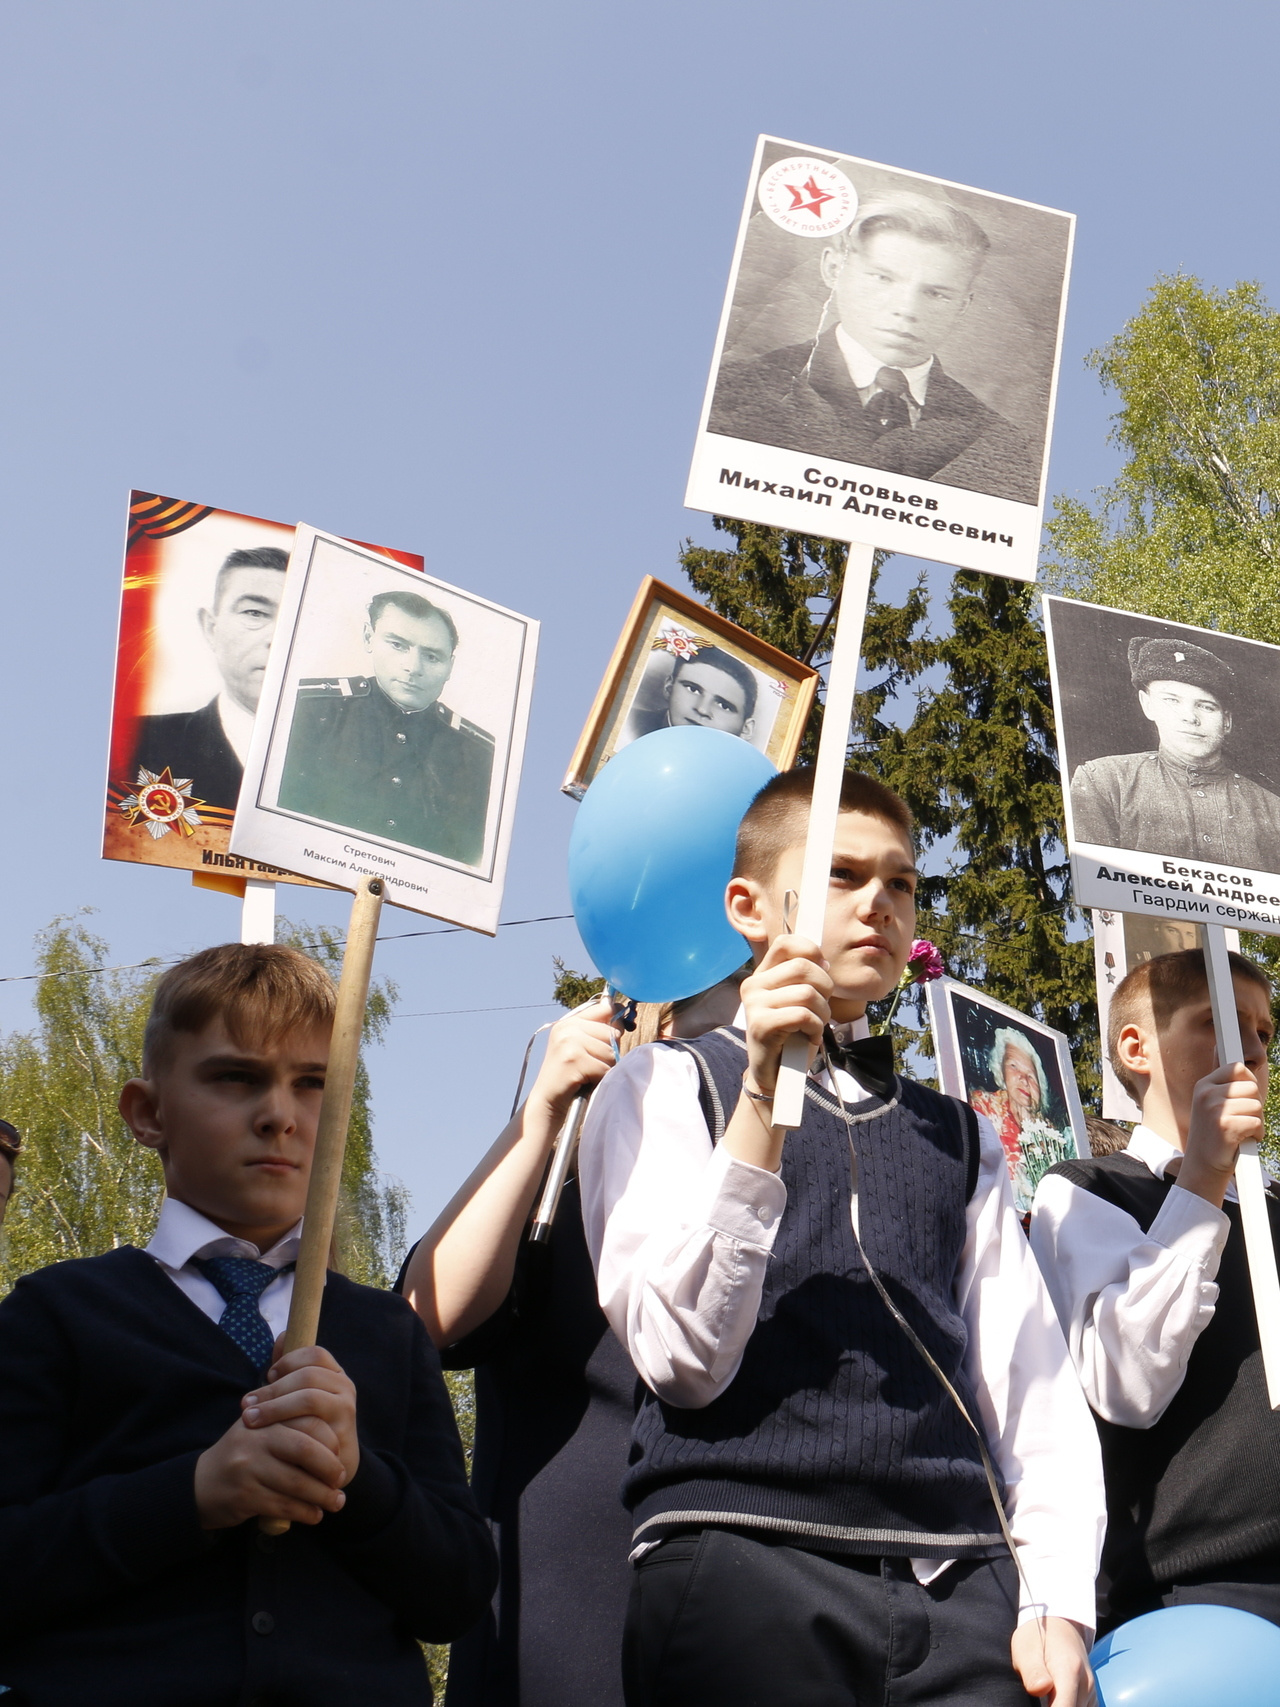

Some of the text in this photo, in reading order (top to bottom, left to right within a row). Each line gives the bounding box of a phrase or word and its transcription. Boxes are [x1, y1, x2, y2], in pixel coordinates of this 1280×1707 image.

[767, 163, 850, 210] БЕССМЕРТНЫЙ ПОЛК
[780, 214, 798, 227] ЛЕТ
[801, 217, 841, 232] ПОБЕДЫ
[803, 467, 939, 511] Соловьев
[719, 468, 1014, 547] Михаил Алексеевич
[202, 849, 245, 869] Илья
[343, 844, 396, 868] Стретович
[303, 848, 429, 894] Максим Александрович
[1096, 866, 1193, 893] Алексей
[1162, 861, 1253, 887] Бекасов
[1132, 890, 1210, 914] Гвардии
